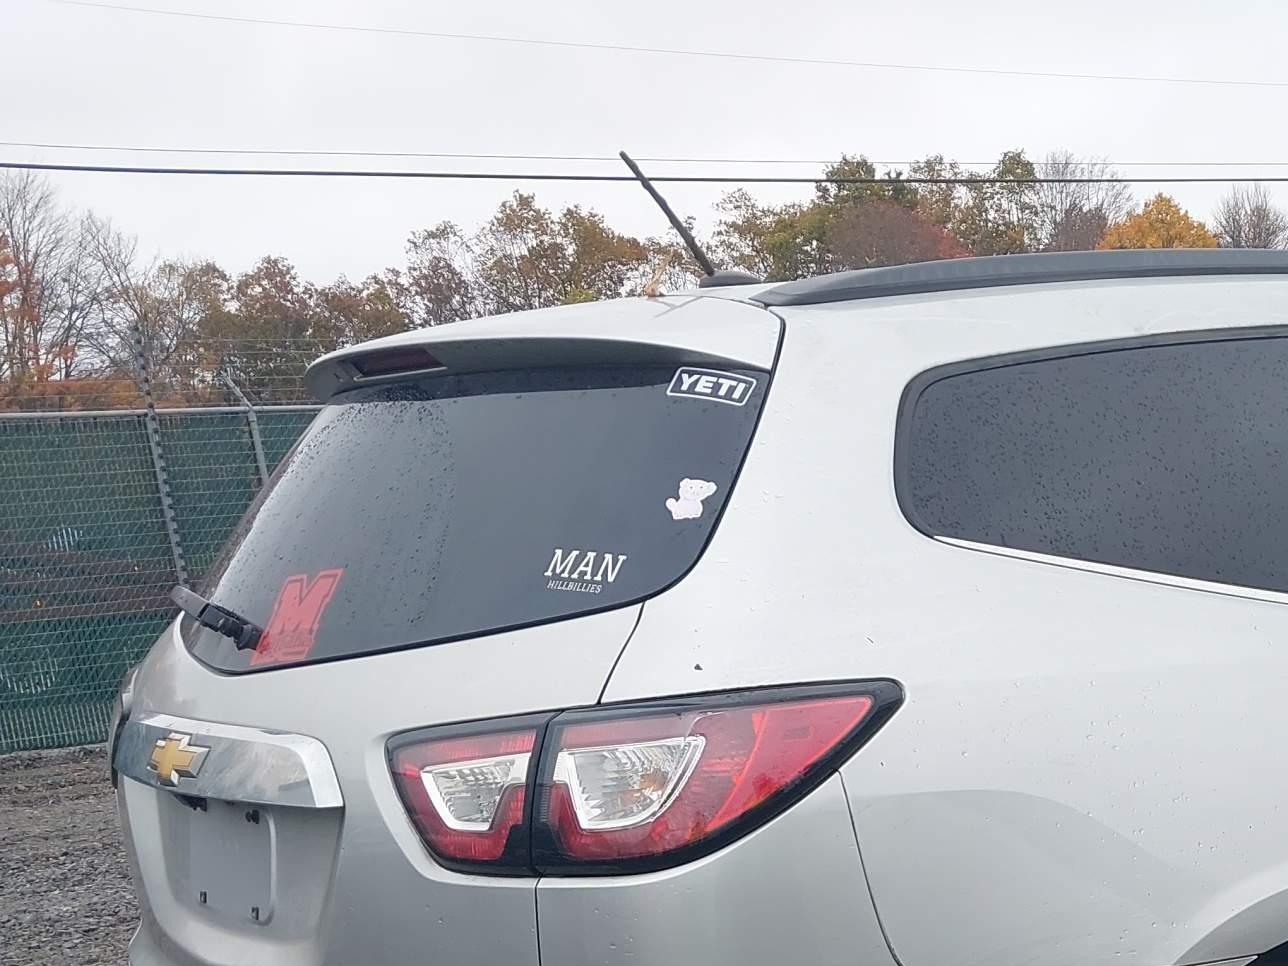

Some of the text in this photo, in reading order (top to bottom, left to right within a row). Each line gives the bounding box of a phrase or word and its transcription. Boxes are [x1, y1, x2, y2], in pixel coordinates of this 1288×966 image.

[680, 373, 747, 399] YETI
[543, 548, 627, 583] MAN
[547, 580, 603, 594] HILLBILLIES
